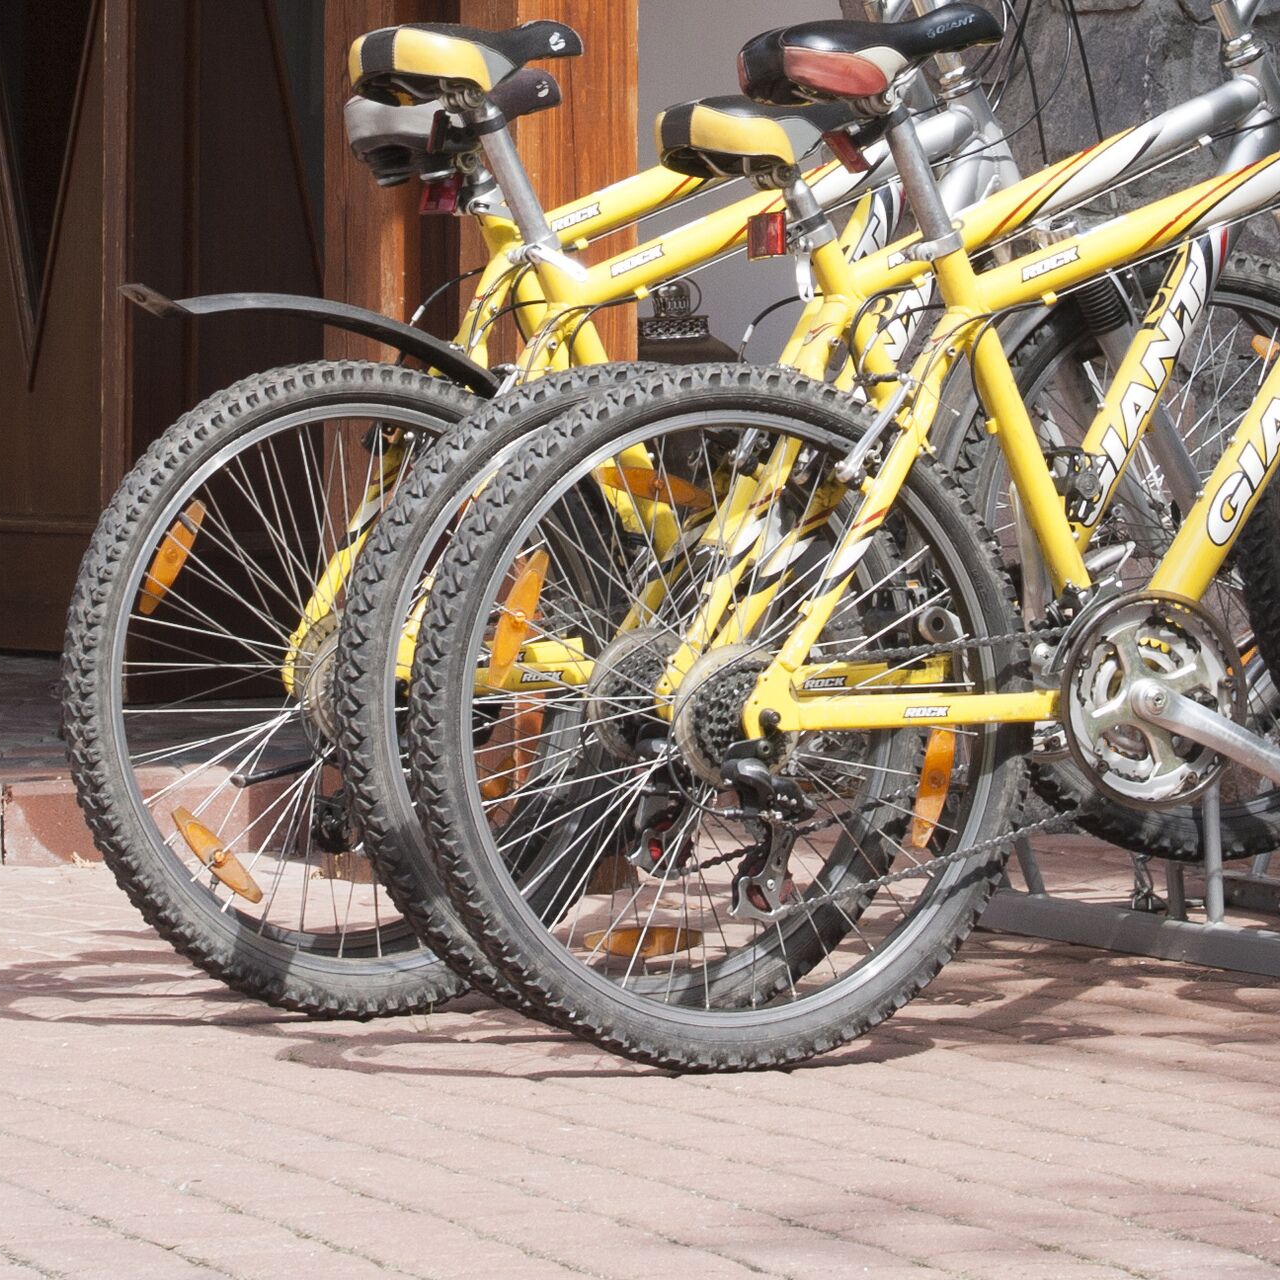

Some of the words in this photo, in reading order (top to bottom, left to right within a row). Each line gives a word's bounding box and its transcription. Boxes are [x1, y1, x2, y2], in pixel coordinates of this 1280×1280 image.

[936, 13, 976, 34] GIANT
[803, 675, 848, 690] ROCK
[903, 705, 951, 718] ROCK
